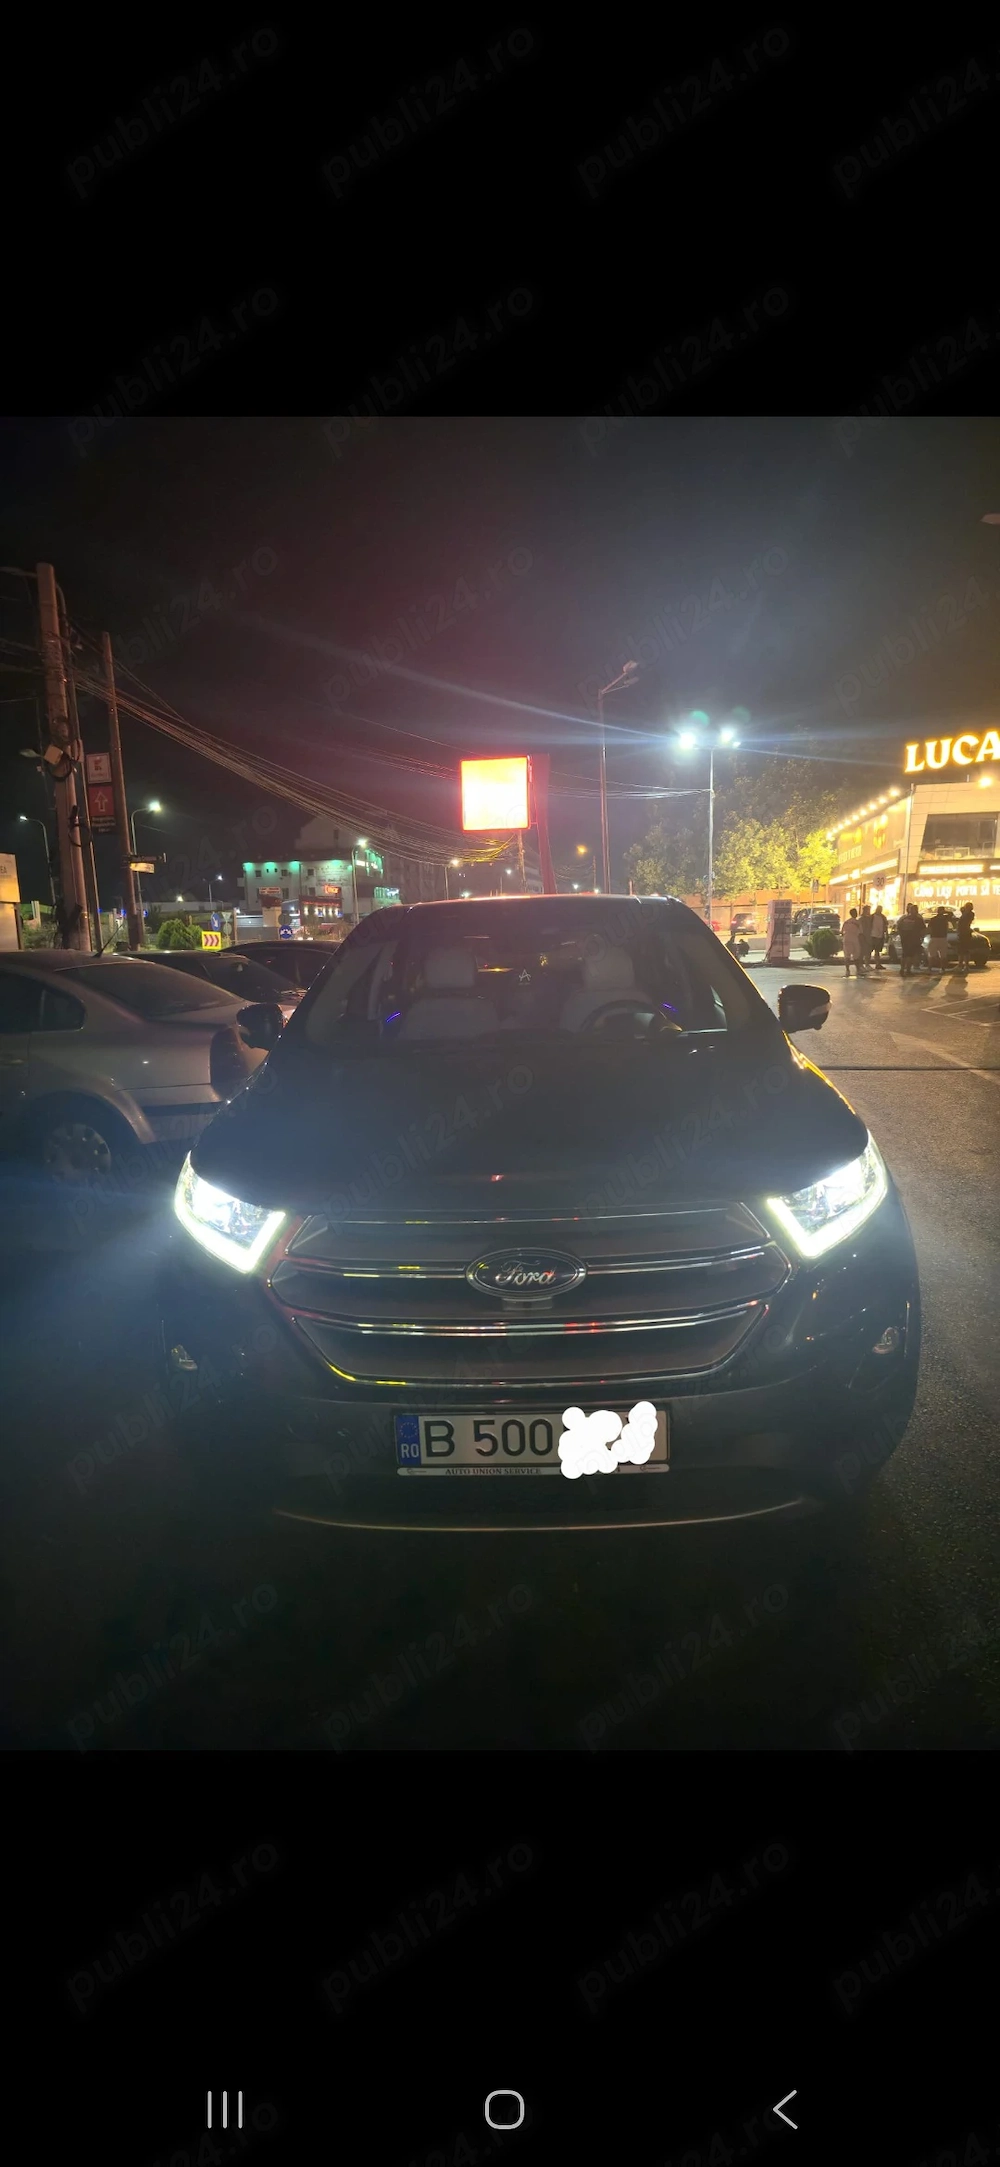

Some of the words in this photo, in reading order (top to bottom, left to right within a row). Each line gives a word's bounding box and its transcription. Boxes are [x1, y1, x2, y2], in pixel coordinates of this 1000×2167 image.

[876, 877, 885, 887] 30
[495, 1259, 557, 1286] Ford
[423, 1420, 455, 1458] B
[473, 1418, 553, 1457] 500
[401, 1443, 420, 1459] RO
[504, 1467, 541, 1475] SERVICE
